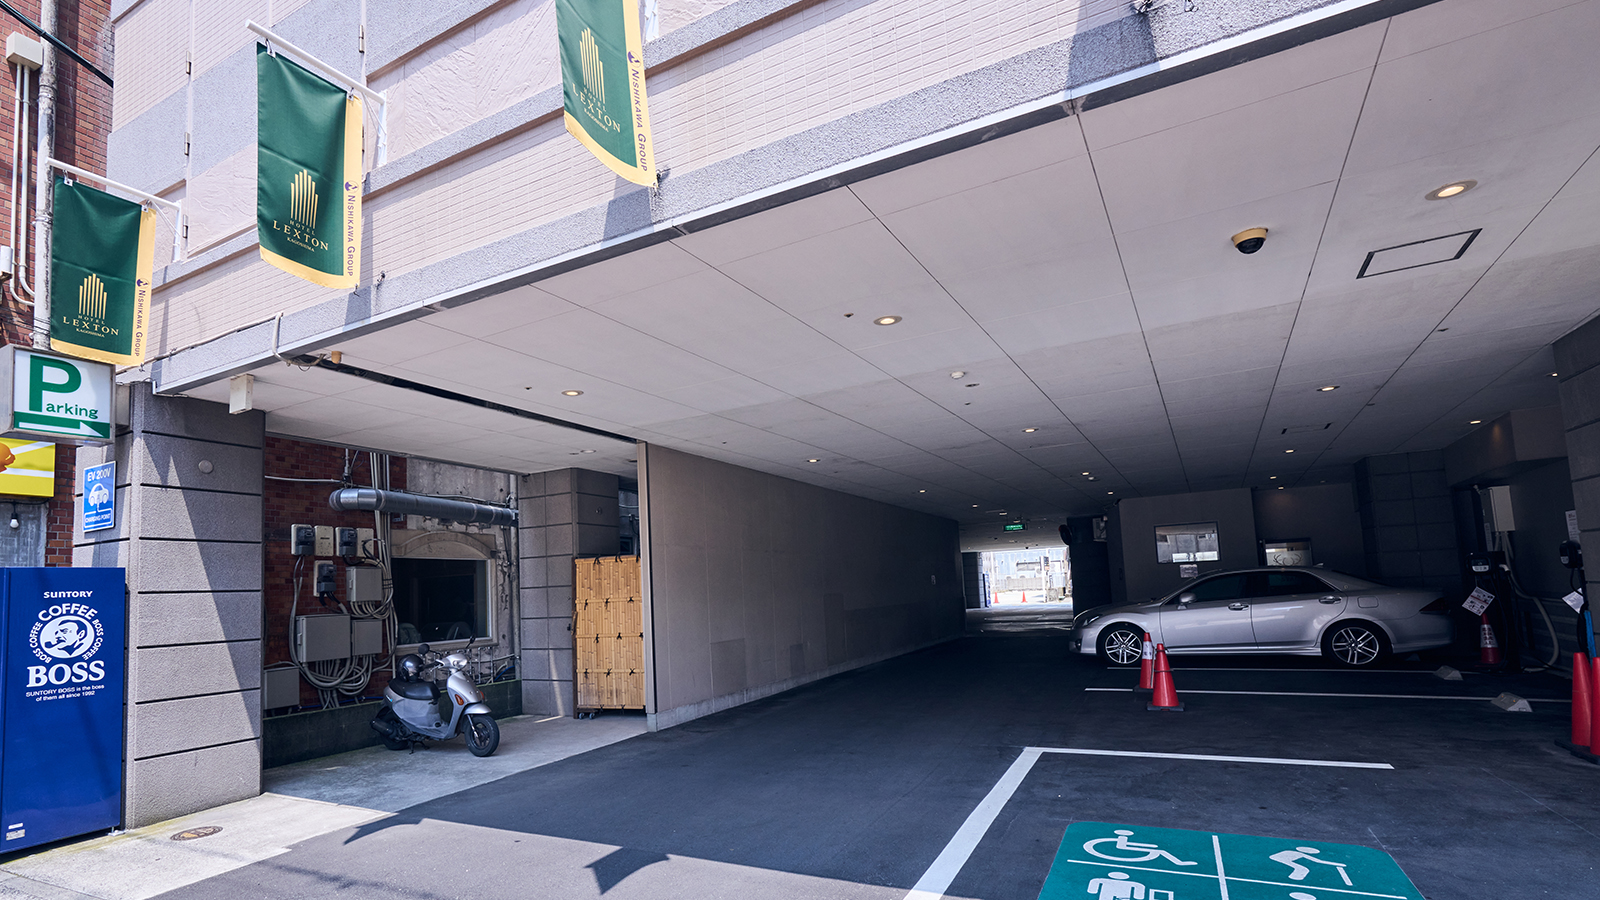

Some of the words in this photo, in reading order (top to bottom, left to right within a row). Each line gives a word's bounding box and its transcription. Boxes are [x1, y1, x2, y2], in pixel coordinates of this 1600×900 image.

[572, 82, 620, 133] LEXTON
[632, 68, 643, 128] NISHIKAWA
[638, 133, 647, 171] GROUP
[290, 220, 315, 235] HOTEL
[347, 195, 355, 242] NISHIKAWA
[273, 220, 328, 250] LEXTON
[347, 246, 355, 276] GROUP
[78, 315, 105, 325] HOTEL
[136, 290, 146, 329] NISHIKAWA
[63, 316, 119, 335] LEXTON
[135, 331, 143, 356] GROUP
[88, 471, 95, 481] EV
[96, 468, 111, 480] 200V
[38, 603, 98, 621] COFFEE
[29, 622, 43, 648] COFFEE
[92, 619, 104, 636] BOSS
[33, 648, 52, 663] BOSS
[82, 637, 103, 660] COFFEE
[26, 660, 105, 687] BOSS
[26, 689, 57, 697] SUNTORY
